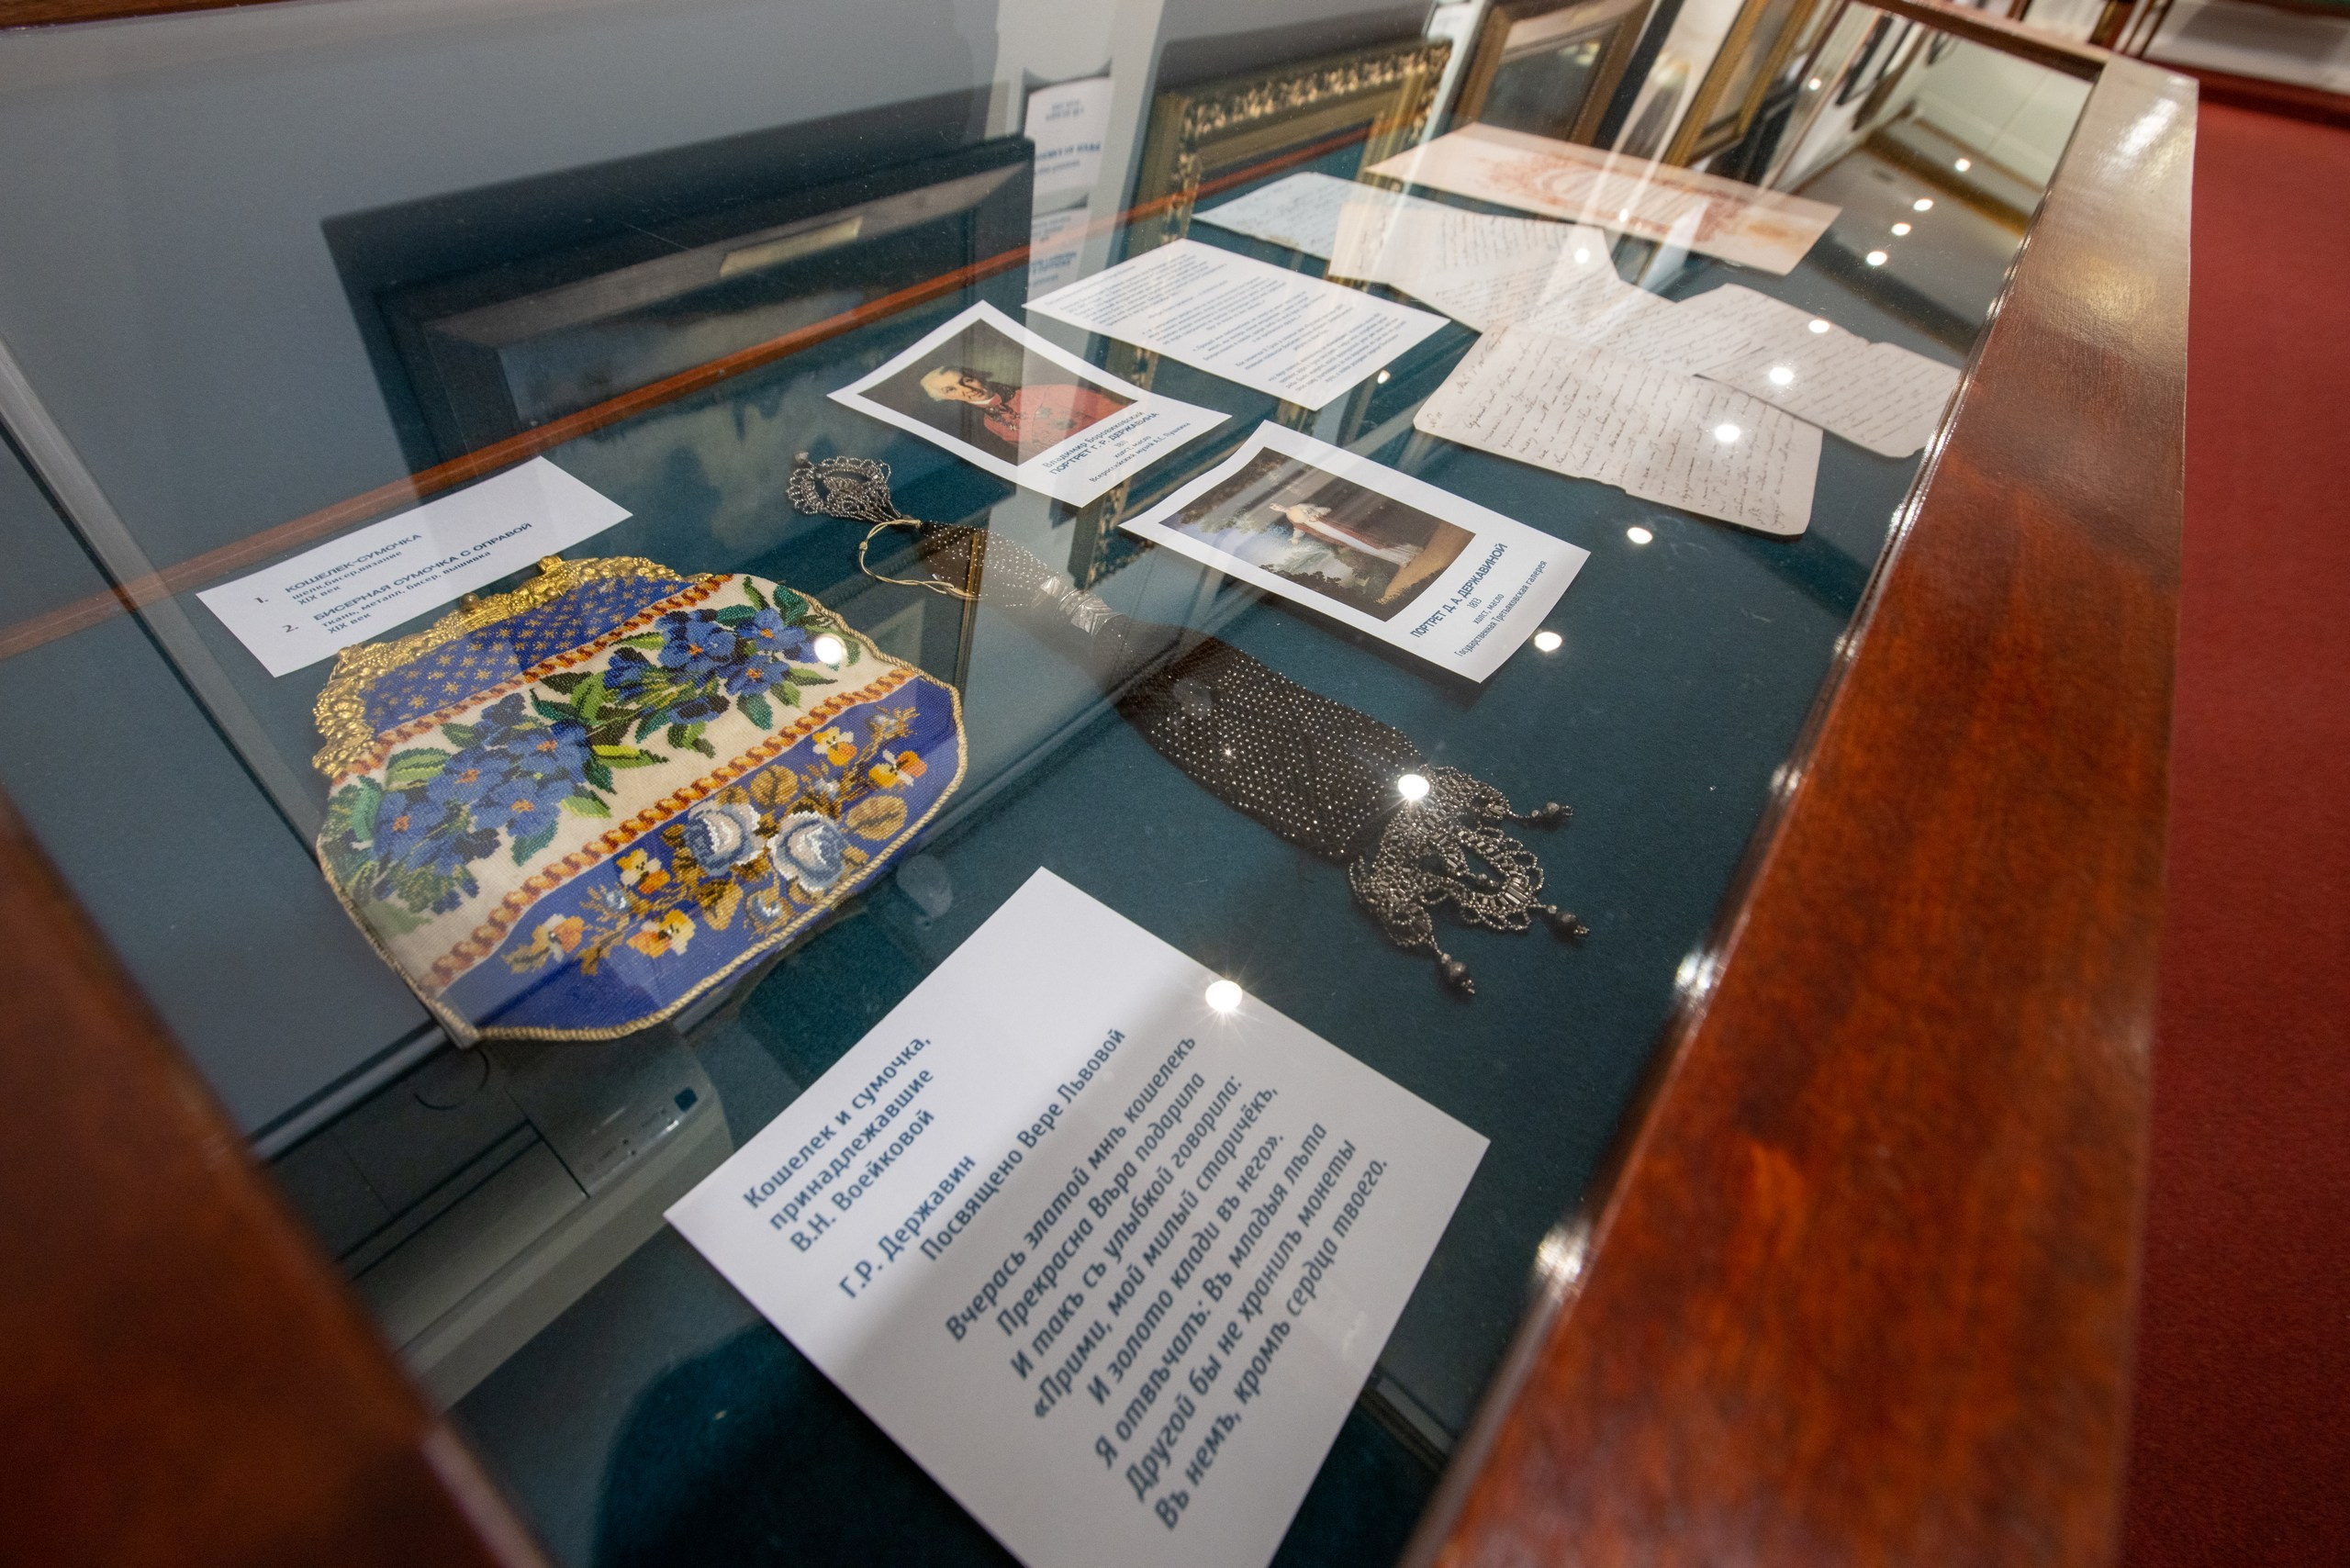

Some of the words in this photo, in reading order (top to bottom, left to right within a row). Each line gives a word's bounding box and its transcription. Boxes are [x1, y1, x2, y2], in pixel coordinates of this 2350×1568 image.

[1043, 442, 1088, 467] Владимир
[1050, 448, 1091, 474] ПОРТРЕТ
[1108, 413, 1159, 441] ДЕРЖАВИНА
[282, 624, 299, 633] 2.
[313, 585, 391, 621] БИСЕРНАЯ
[394, 556, 459, 586] СУМОЧКА
[473, 523, 532, 551] ОПРАВОЙ
[285, 534, 421, 593] КОШЕЛЕК-СУМОЧКА
[320, 586, 341, 596] век
[350, 613, 371, 624] век
[361, 590, 405, 610] металл,
[406, 575, 442, 589] бисер,
[1410, 610, 1446, 638] ПОРТРЕТ
[1457, 543, 1507, 599] ДЕРЖАВИНОЙ
[1454, 622, 1497, 656] Государственная
[1491, 585, 1529, 622] Третьяковская
[1526, 561, 1547, 585] галерея
[1467, 598, 1482, 609] 1813
[743, 1125, 837, 1209] Кошелек
[834, 1110, 853, 1126] и
[851, 1038, 932, 1110] сумочка,
[769, 1070, 934, 1231] принадлежавшие
[789, 1212, 837, 1253] В.Н.
[830, 1108, 935, 1212] Воейковой
[919, 1149, 1024, 1262] Посвящено
[1016, 1103, 1065, 1150] Вере
[1056, 1028, 1126, 1105] Львовой
[945, 1251, 1026, 1343] Вчерась
[1023, 1166, 1091, 1251] златой
[1123, 1037, 1196, 1125] кошелекъ
[838, 1260, 884, 1299] Г.Р.
[877, 1155, 977, 1264] Державин
[995, 1217, 1094, 1338] Прекрасна
[1134, 1072, 1206, 1163] подарила
[1010, 1350, 1035, 1380] И
[1031, 1292, 1085, 1358] такъ
[1081, 1261, 1107, 1289] съ
[1102, 1165, 1175, 1265] улыбкой
[1170, 1075, 1242, 1170] говорила:
[1087, 1374, 1112, 1406] И
[1106, 1289, 1174, 1384] золото
[1169, 1221, 1221, 1292] клади
[1215, 1195, 1241, 1224] въ
[1235, 1135, 1284, 1194] него».
[1034, 1319, 1113, 1418] «Прими,
[1106, 1263, 1147, 1317] мой
[1141, 1189, 1200, 1269] милый
[1094, 1435, 1119, 1470] Я
[1201, 1271, 1233, 1304] Въ
[1227, 1182, 1289, 1271] младыя
[1125, 1393, 1196, 1505] Другой
[1188, 1353, 1223, 1396] бы
[1216, 1320, 1244, 1357] не
[1237, 1229, 1303, 1324] хранилъ
[1296, 1138, 1357, 1228] монеты
[1154, 1490, 1191, 1531] Въ
[1184, 1412, 1242, 1487] немъ,
[1285, 1237, 1338, 1317] сердца
[1332, 1159, 1388, 1239] твоего.
